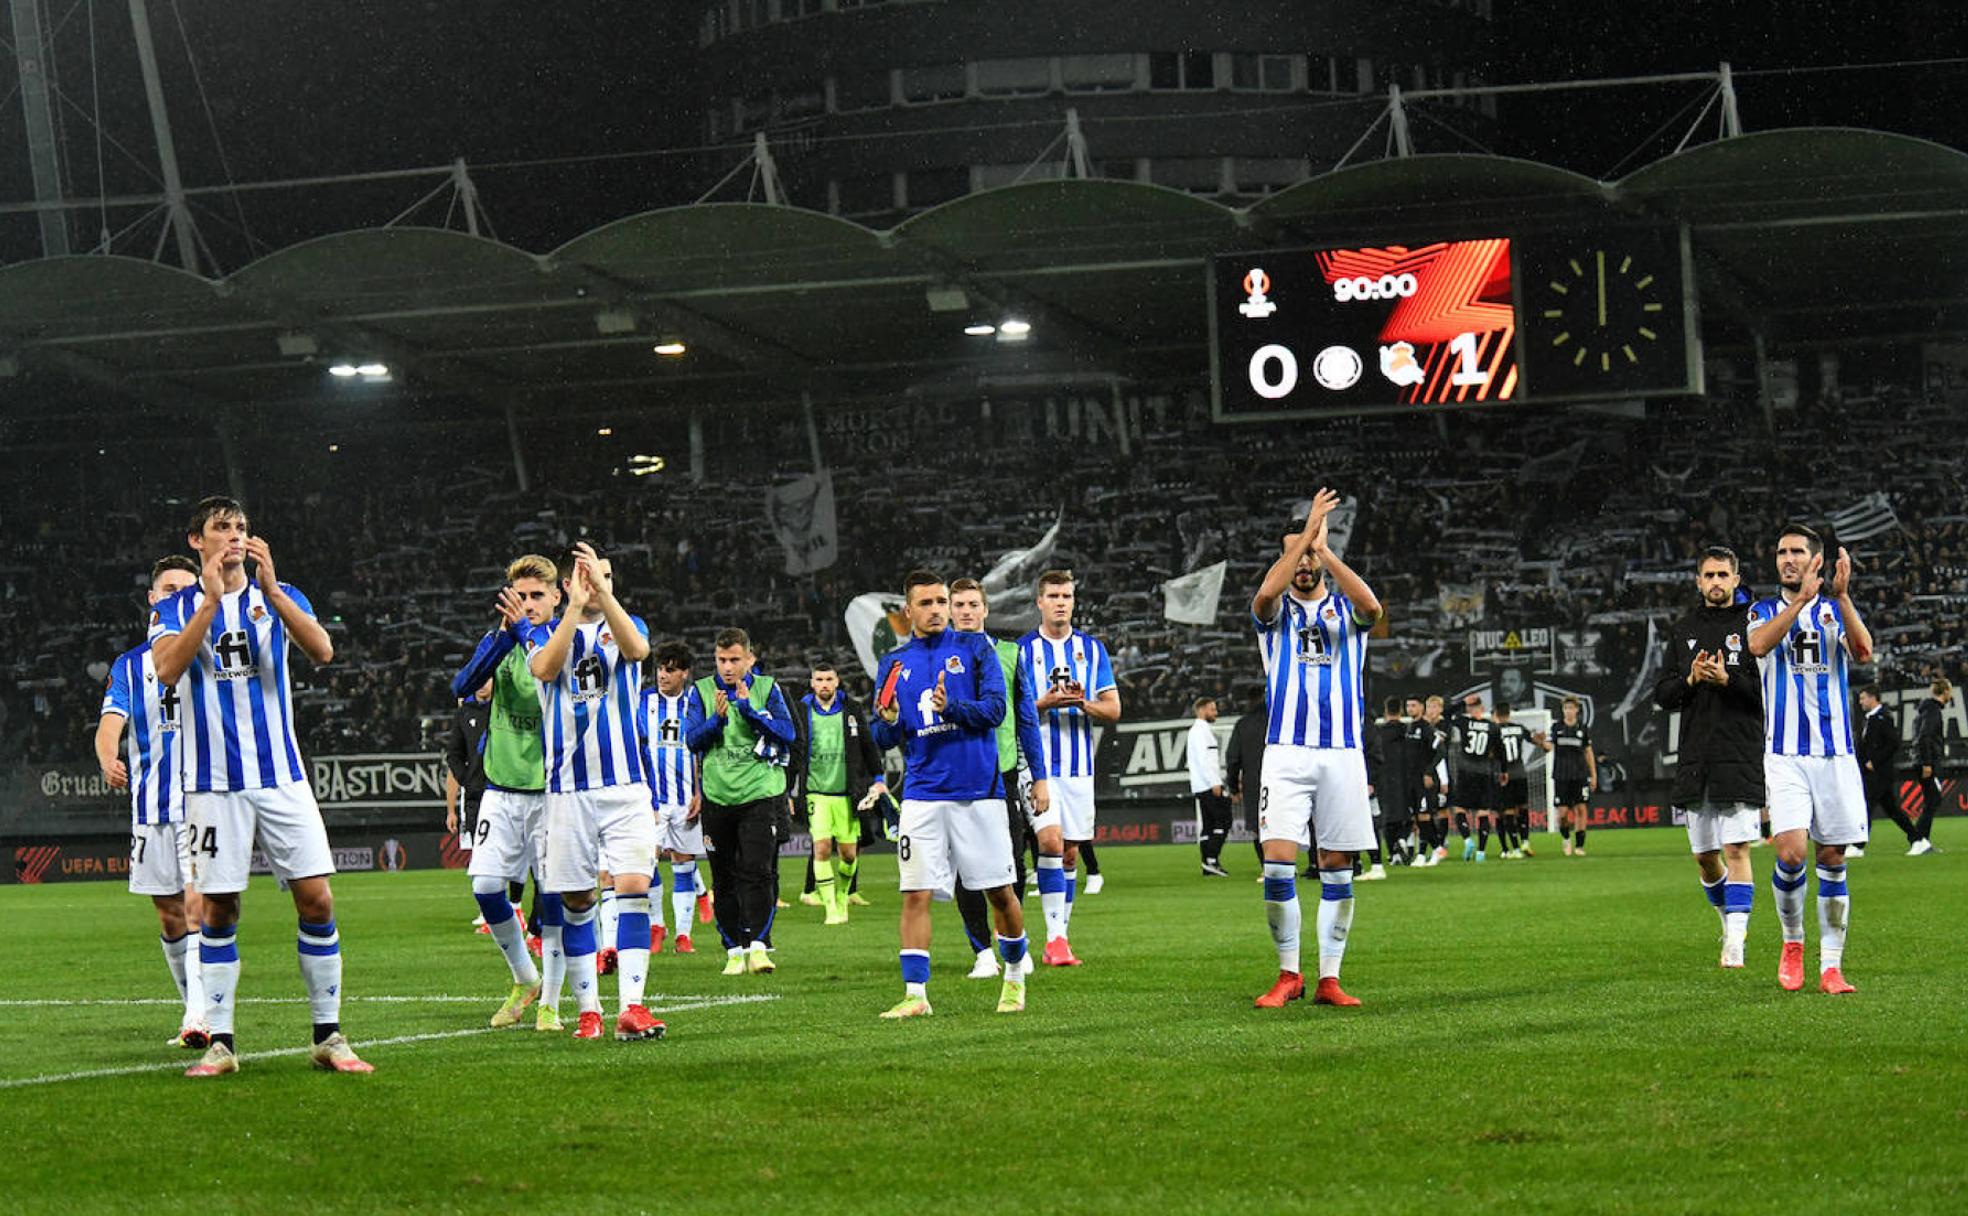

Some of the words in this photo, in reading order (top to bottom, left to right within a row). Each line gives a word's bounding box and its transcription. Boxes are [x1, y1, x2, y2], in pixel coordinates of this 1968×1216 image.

[1333, 272, 1418, 302] 90:00
[1248, 344, 1299, 399] 0
[1449, 332, 1489, 386] 1
[1465, 730, 1489, 755] 30
[1503, 736, 1518, 763] 11
[189, 823, 219, 859] 24
[1095, 822, 1161, 843] EAGUE
[62, 857, 103, 875] UEFA
